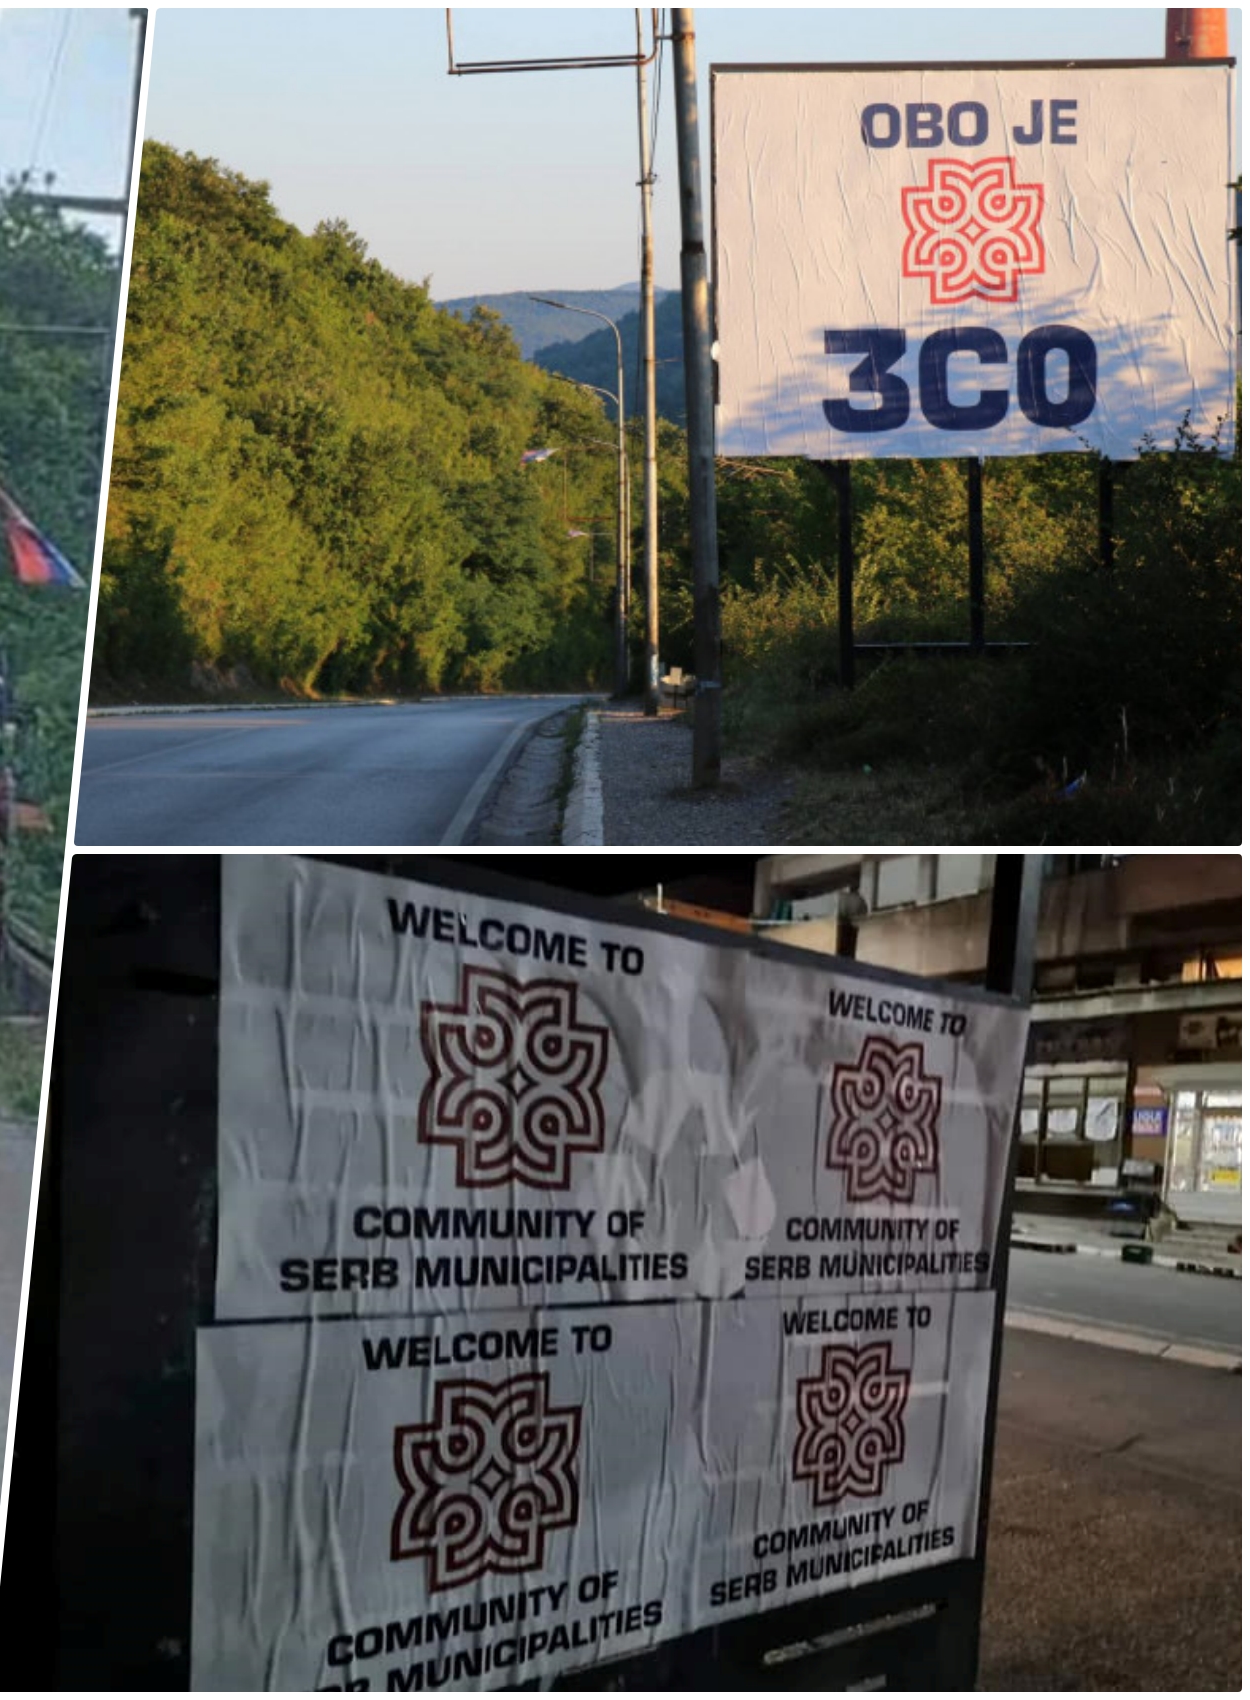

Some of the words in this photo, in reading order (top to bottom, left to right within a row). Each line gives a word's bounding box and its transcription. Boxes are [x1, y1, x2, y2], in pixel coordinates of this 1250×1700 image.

[386, 896, 588, 967] WELCOME
[600, 941, 645, 976] TO
[828, 988, 935, 1032] WELCOME
[940, 1012, 968, 1037] TO
[353, 1206, 596, 1240] COMMUNITY
[606, 1210, 645, 1238] OF
[786, 1217, 929, 1242] COMMUNITY
[935, 1218, 961, 1241] OF
[279, 1258, 399, 1293] SERB
[414, 1253, 689, 1290] MUNICIPALITIES
[745, 1254, 811, 1281] SERB
[819, 1251, 991, 1279] MUNICIPALITIES
[783, 1307, 899, 1336] WELCOME
[906, 1305, 932, 1329] TO
[362, 1327, 559, 1370] WELCOME
[570, 1324, 613, 1354] TO
[753, 1506, 896, 1559] COMMUNITY
[902, 1500, 929, 1525] OF
[710, 1569, 777, 1607] SERB
[786, 1526, 955, 1588] MUNICIPALITIES
[327, 1580, 569, 1667] COMMUNITY
[578, 1570, 619, 1603] OF
[386, 1600, 663, 1692] MUNICIPALITIES
